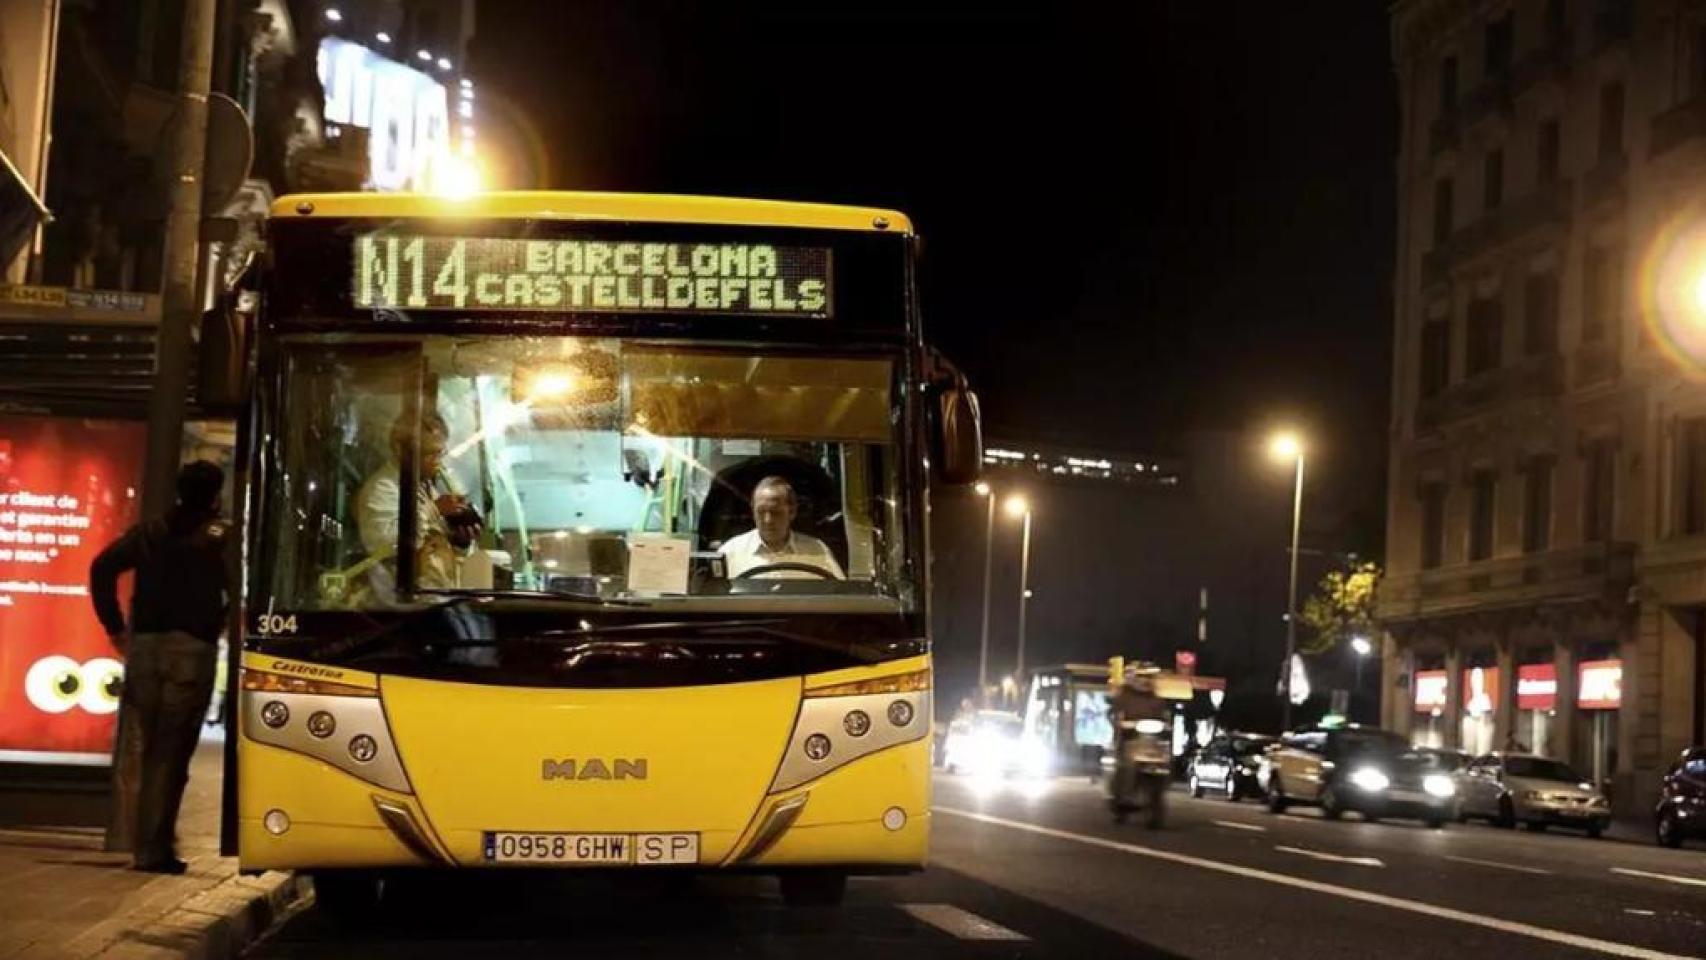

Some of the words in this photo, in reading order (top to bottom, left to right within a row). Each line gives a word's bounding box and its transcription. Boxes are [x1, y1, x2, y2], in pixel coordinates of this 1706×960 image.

[360, 237, 468, 308] N14
[475, 274, 826, 311] CASTELLDEFELS
[10, 491, 56, 507] client
[57, 495, 78, 509] de
[258, 614, 298, 634] 304
[542, 758, 648, 781] MAN
[501, 835, 566, 858] 0958
[576, 836, 624, 859] GHW
